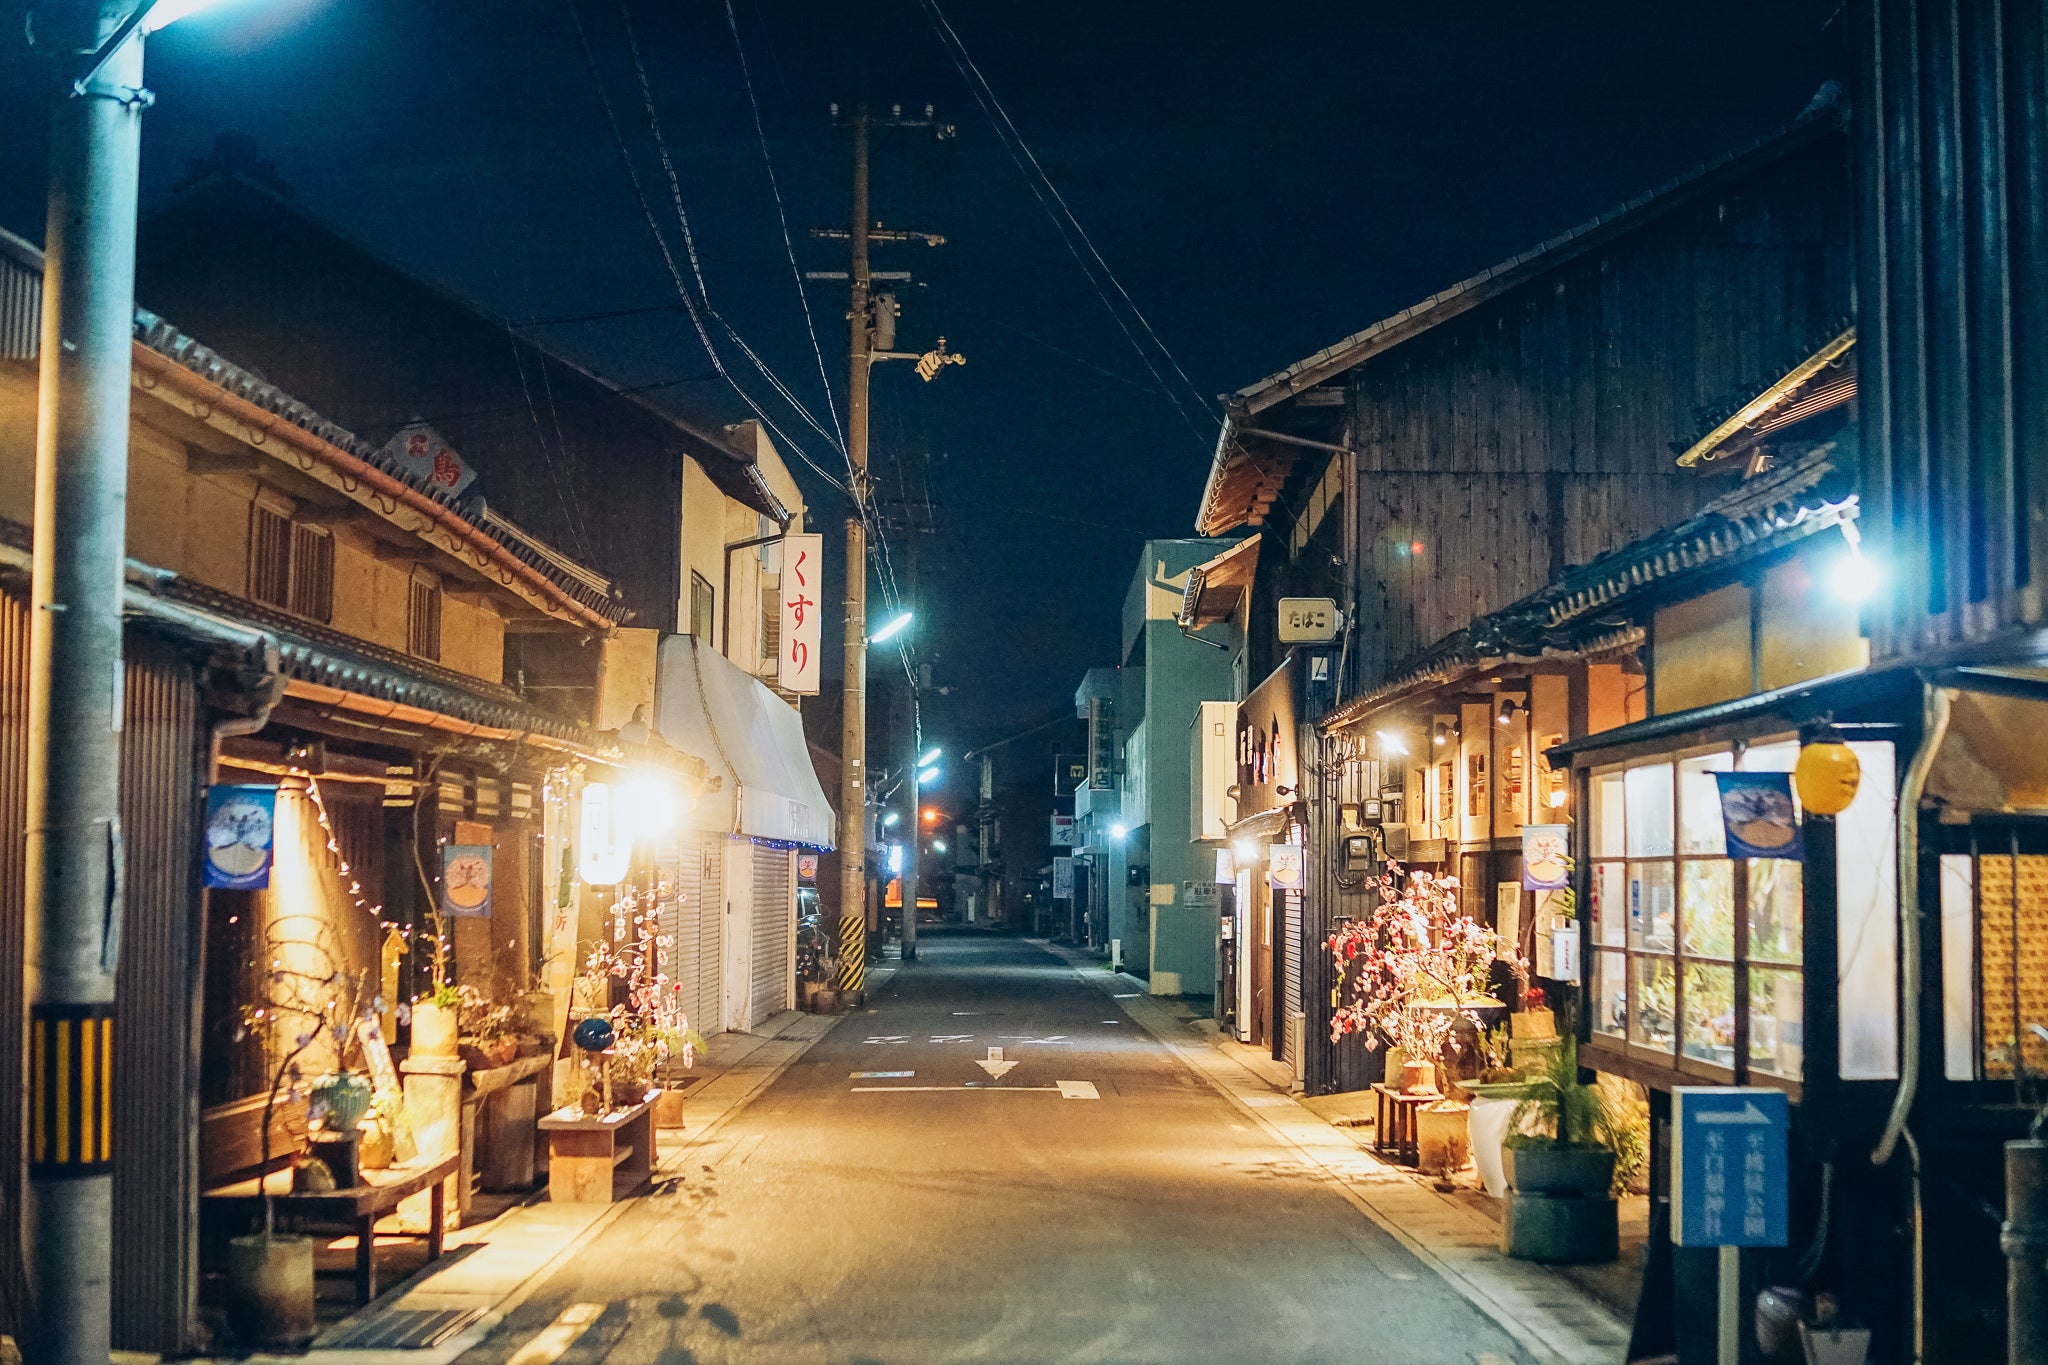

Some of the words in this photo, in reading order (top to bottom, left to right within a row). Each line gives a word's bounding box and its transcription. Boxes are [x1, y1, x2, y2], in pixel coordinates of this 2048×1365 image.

[787, 550, 814, 676] くすり
[1288, 611, 1325, 629] たばこ
